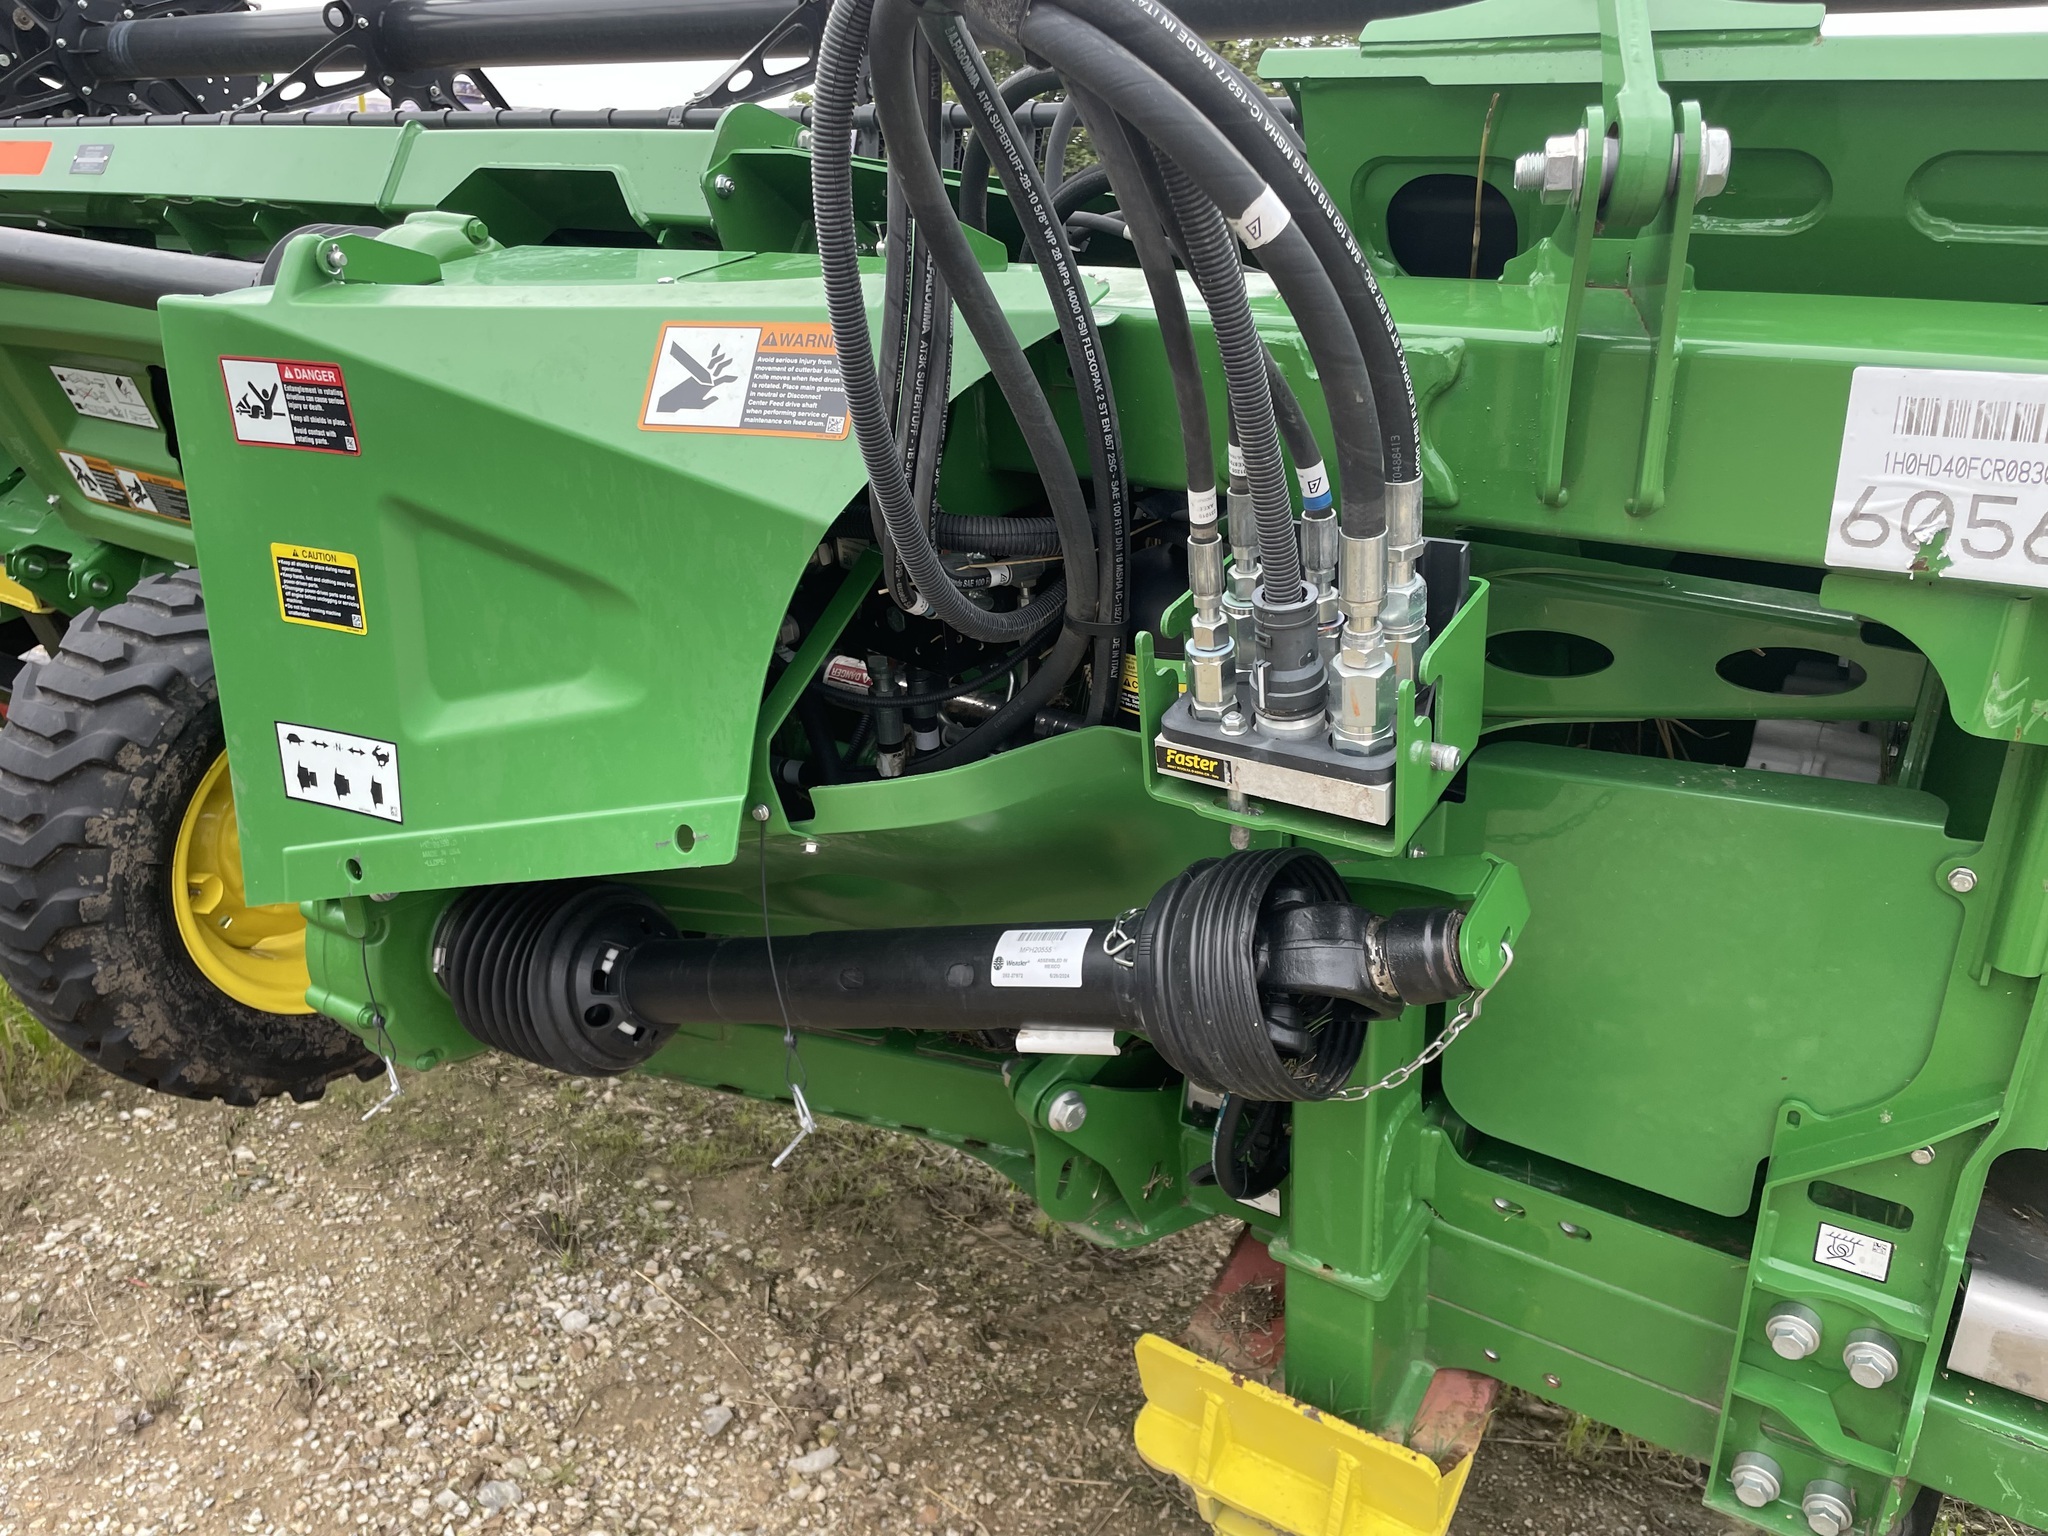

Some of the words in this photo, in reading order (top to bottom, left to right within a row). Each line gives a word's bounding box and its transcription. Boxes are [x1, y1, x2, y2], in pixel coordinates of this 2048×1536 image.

[1160, 14, 1177, 32] IN
[1177, 29, 1217, 70] MADE
[947, 32, 980, 90] ALFAGOMMA
[976, 90, 995, 115] AT4K
[1216, 68, 1263, 122] IC-152/7
[1264, 120, 1293, 160] MSHA
[990, 112, 1038, 205] SUPERTUFF-2B-10
[1292, 158, 1304, 174] 16
[1304, 172, 1320, 196] DN
[1033, 204, 1050, 226] 5/8"
[1318, 193, 1334, 219] R19
[1044, 226, 1058, 246] WP
[1333, 216, 1348, 238] 100
[1051, 247, 1062, 262] 28
[1346, 239, 1362, 264] SAE
[1057, 261, 1071, 286] MPa
[1364, 269, 1378, 294] 2SC
[1066, 286, 1081, 314] (4000
[1375, 294, 1387, 314] 857
[1076, 316, 1088, 336] PSI)
[1384, 312, 1394, 332] EN
[780, 333, 835, 348] WARNI
[918, 340, 929, 368] AT3K
[1082, 336, 1103, 393] FLEXOPAK
[294, 368, 336, 382] DANGER
[1400, 356, 1417, 419] FLEXOPAK
[288, 402, 302, 411] injury
[910, 371, 925, 437] SUPERTUFF
[1097, 394, 1105, 402] 2
[291, 414, 303, 423] Keep
[763, 408, 796, 417] performing
[1099, 402, 1109, 416] ST
[294, 427, 307, 435] Avoid
[326, 429, 337, 437] with
[1102, 418, 1111, 432] EN
[1105, 435, 1114, 450] 857
[908, 446, 915, 460] 1B
[1108, 452, 1117, 472] 2SC
[904, 462, 914, 483] 3/8"
[1111, 480, 1121, 499] SAE
[1113, 501, 1122, 518] 100
[1114, 520, 1123, 536] R19
[1116, 538, 1124, 552] DN
[302, 550, 337, 562] CAUTION
[1116, 554, 1124, 562] 16
[1115, 564, 1124, 591] MSHA
[1114, 592, 1123, 624] IC-152/7
[831, 668, 862, 681] DANGER
[1110, 659, 1120, 678] ITALY
[1166, 749, 1218, 772] Faster
